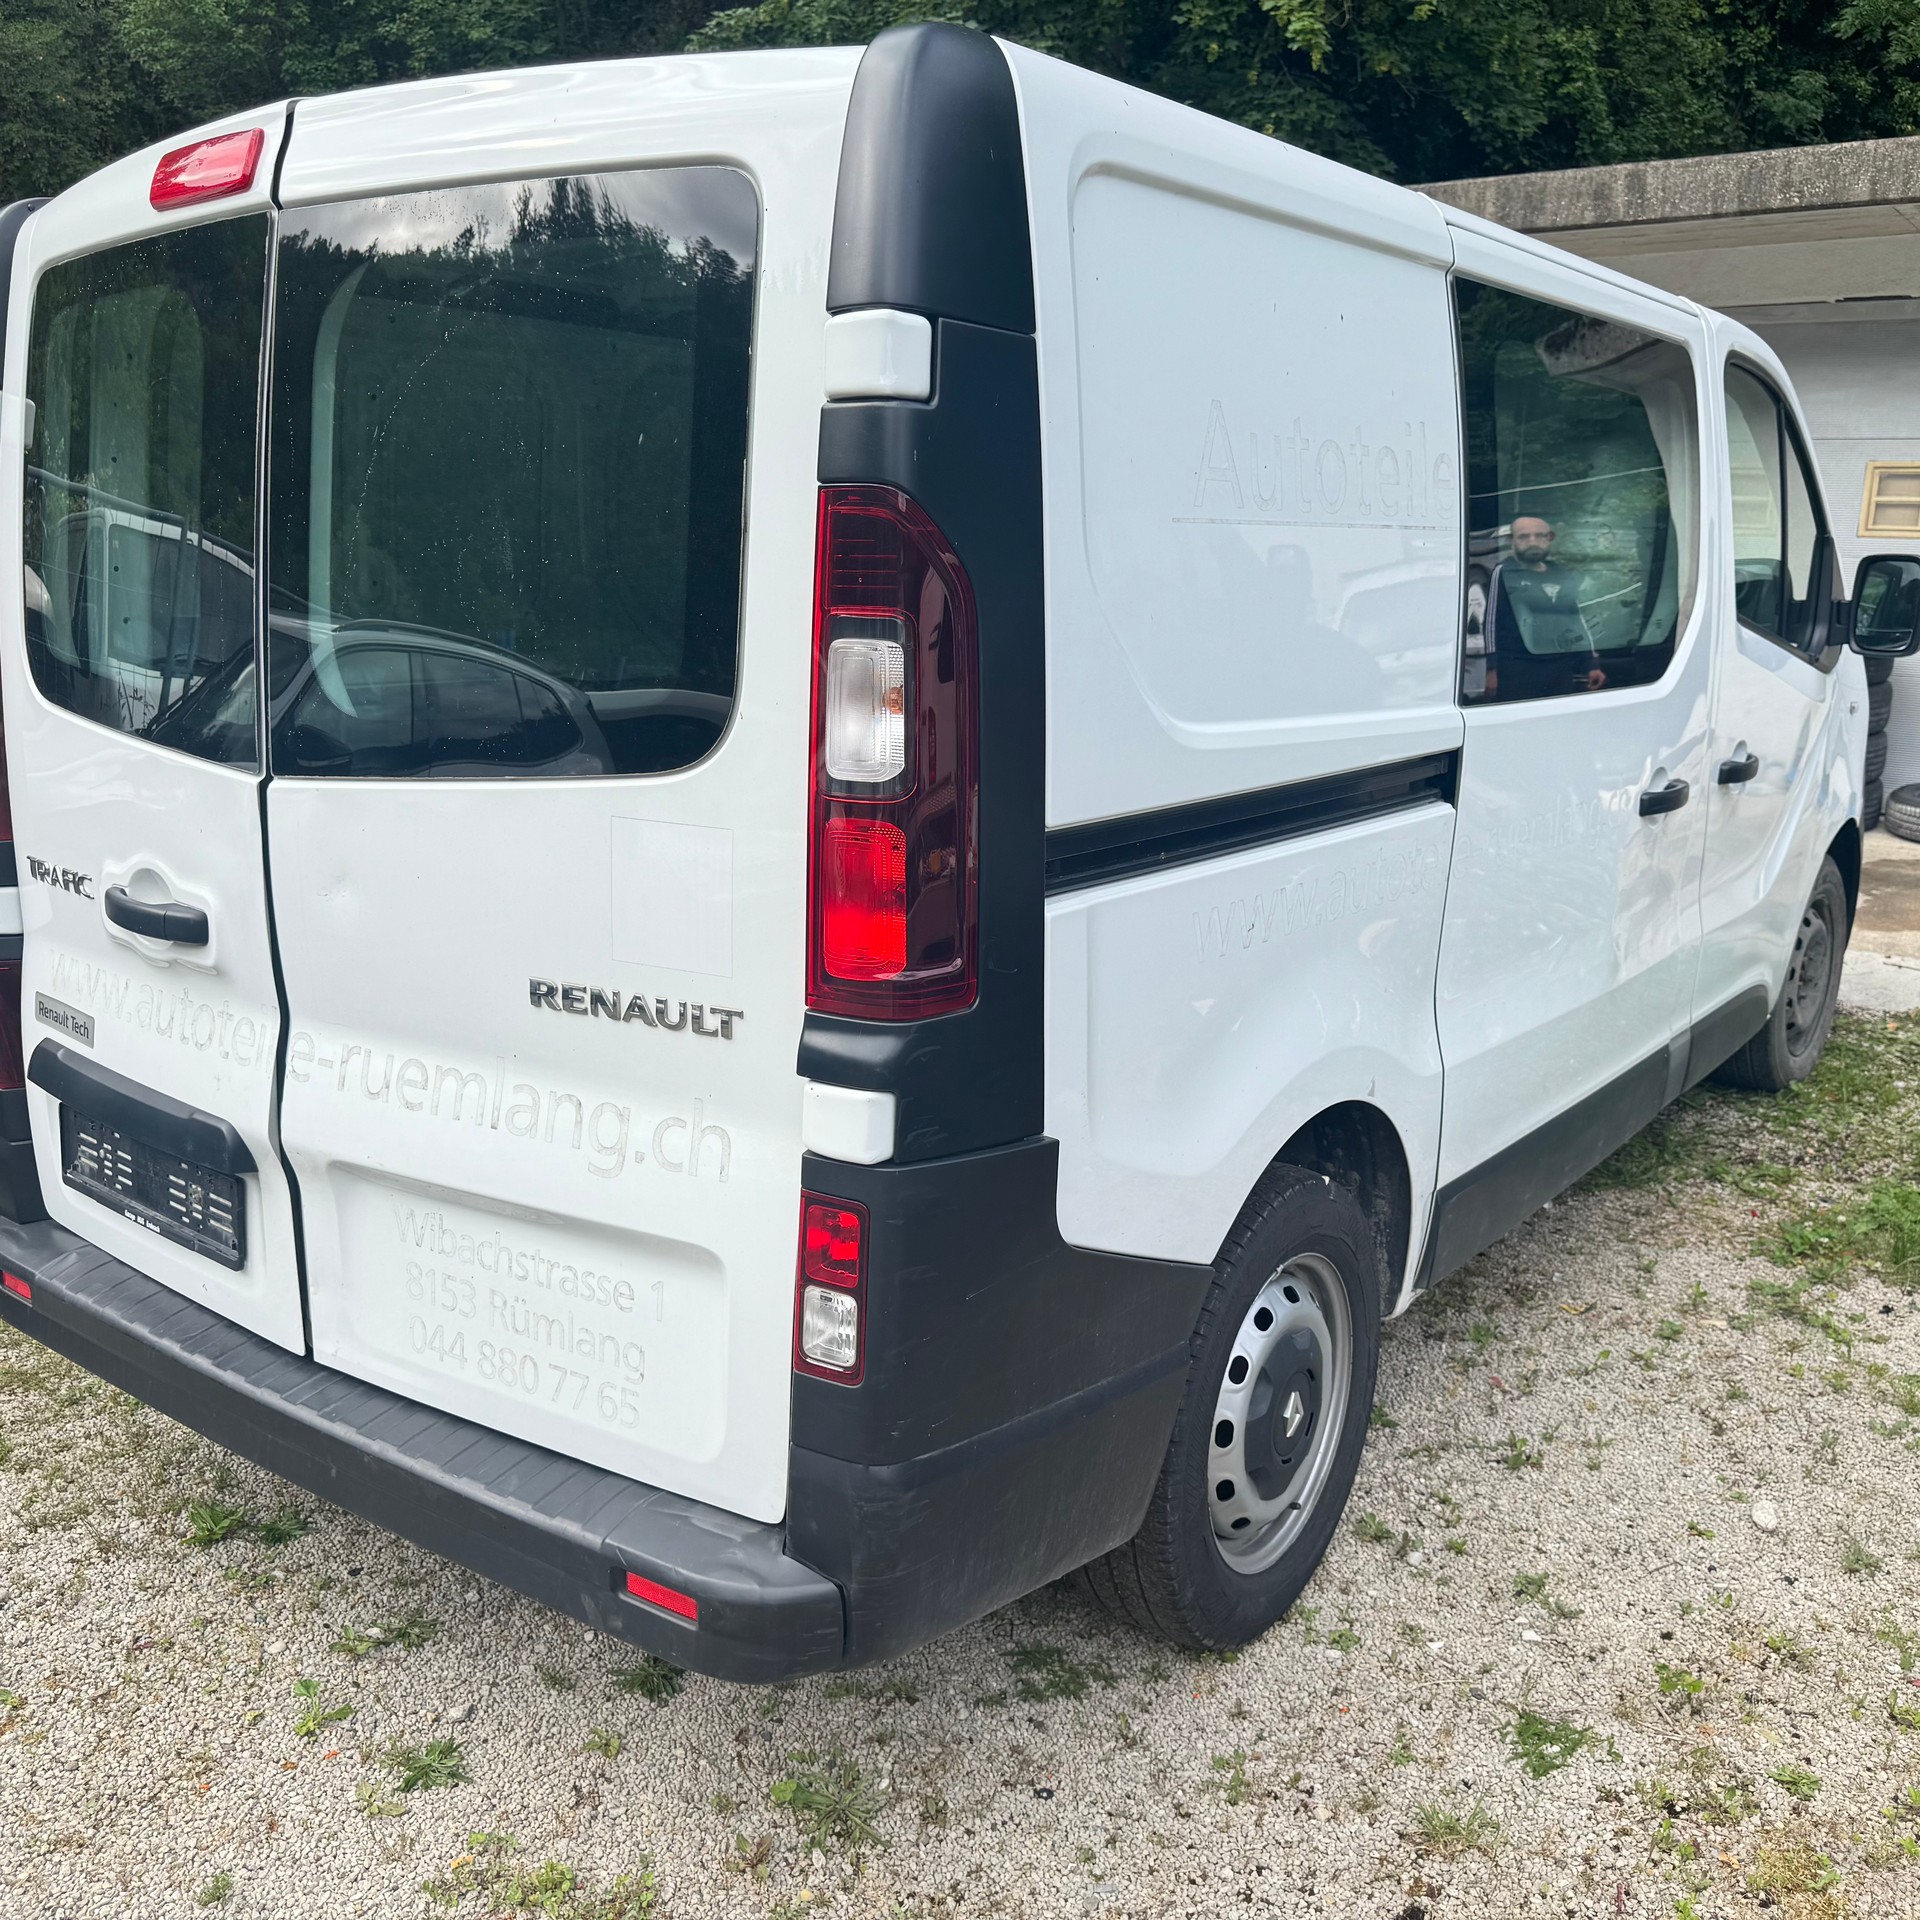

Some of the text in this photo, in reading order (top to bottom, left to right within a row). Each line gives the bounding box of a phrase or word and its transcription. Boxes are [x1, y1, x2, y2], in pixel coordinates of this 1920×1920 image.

[1193, 398, 1454, 519] Autoteile
[26, 855, 95, 900] TRAFIC
[38, 1000, 90, 1039] Renault Tech
[49, 948, 731, 1183] www.autoteile-ruemlang.ch
[528, 976, 743, 1040] RENAULT
[394, 1202, 665, 1323] Wibachstrasse 1
[405, 1260, 647, 1384] 8153 Rümlang
[408, 1313, 641, 1429] 044 880 77 65
